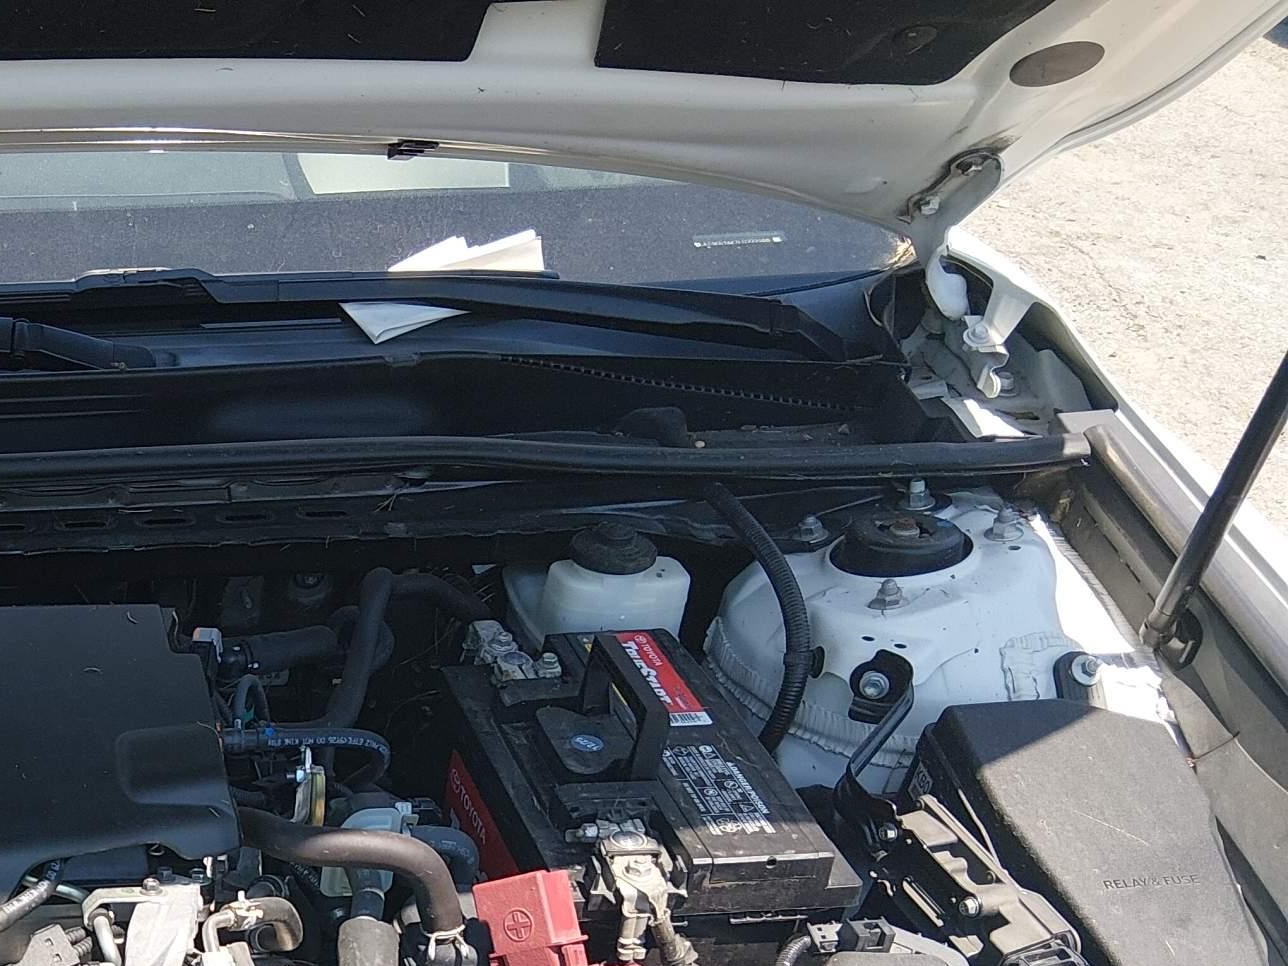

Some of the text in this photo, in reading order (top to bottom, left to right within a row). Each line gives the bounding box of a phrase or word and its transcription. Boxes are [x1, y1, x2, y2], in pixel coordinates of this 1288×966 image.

[640, 643, 663, 667] TOYOTA
[460, 786, 486, 845] TOYOTA
[1103, 878, 1147, 889] RELAY
[1162, 874, 1201, 885] FUSE
